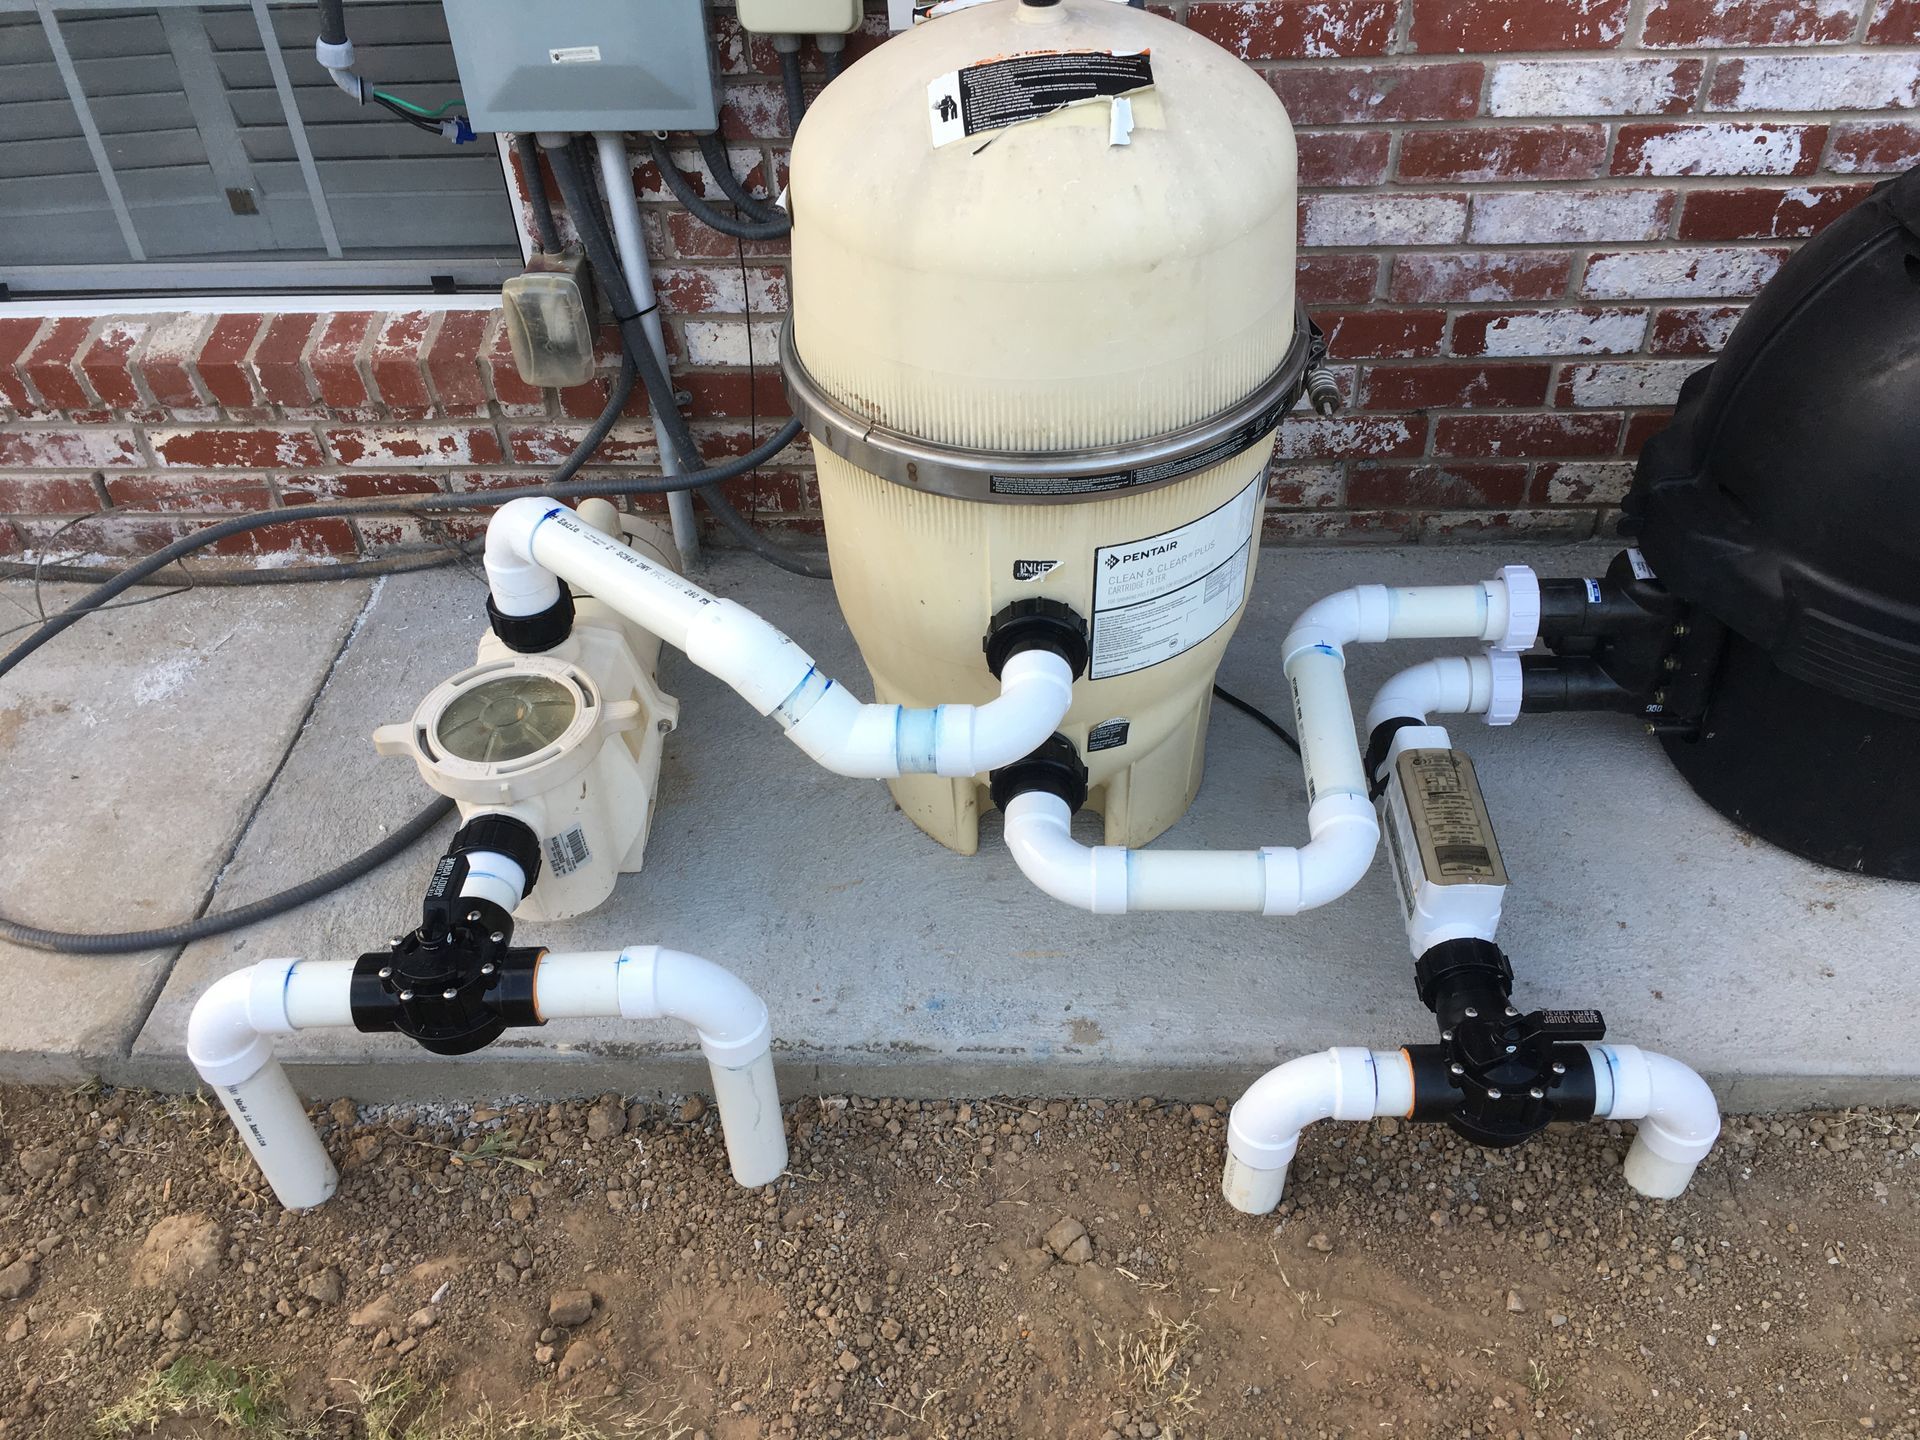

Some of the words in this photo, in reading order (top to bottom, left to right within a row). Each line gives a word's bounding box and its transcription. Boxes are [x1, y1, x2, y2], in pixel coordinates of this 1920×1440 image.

[1108, 570, 1144, 585] CLEAN
[1146, 567, 1154, 577] &
[1194, 541, 1216, 558] PLUS
[1122, 541, 1178, 564] PENTAIR
[1108, 580, 1144, 595] CARTRIDGE
[1146, 573, 1166, 588] FILTER
